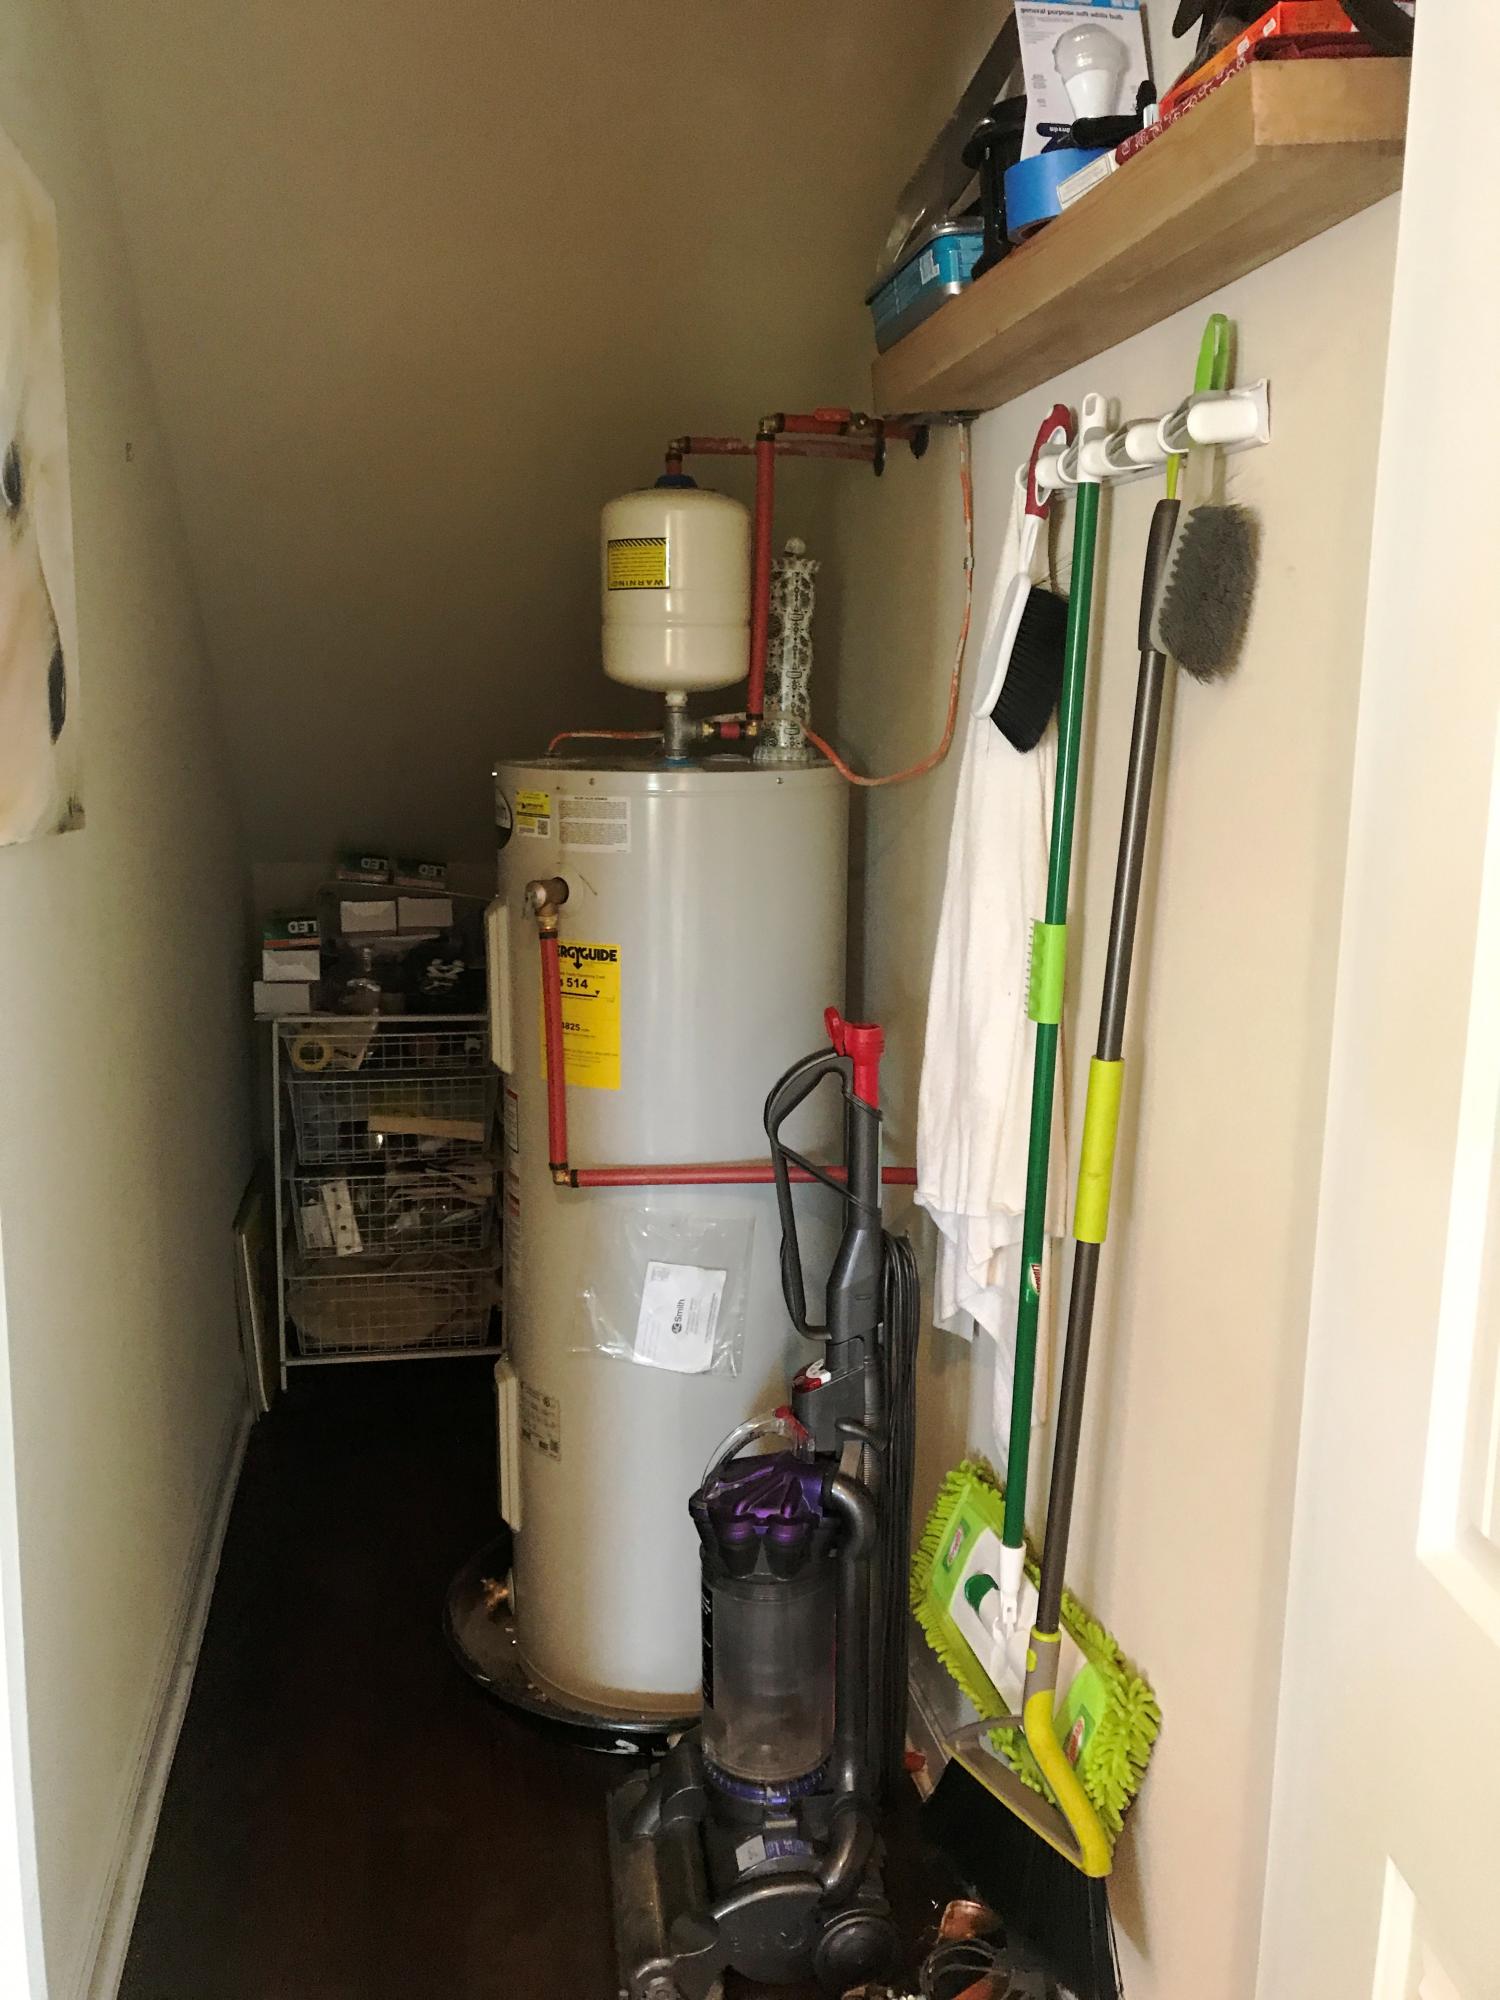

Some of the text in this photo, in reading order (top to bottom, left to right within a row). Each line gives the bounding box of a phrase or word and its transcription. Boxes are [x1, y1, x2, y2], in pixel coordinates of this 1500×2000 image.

[361, 858, 388, 870] LED
[418, 863, 445, 876] LED
[287, 920, 317, 934] LED
